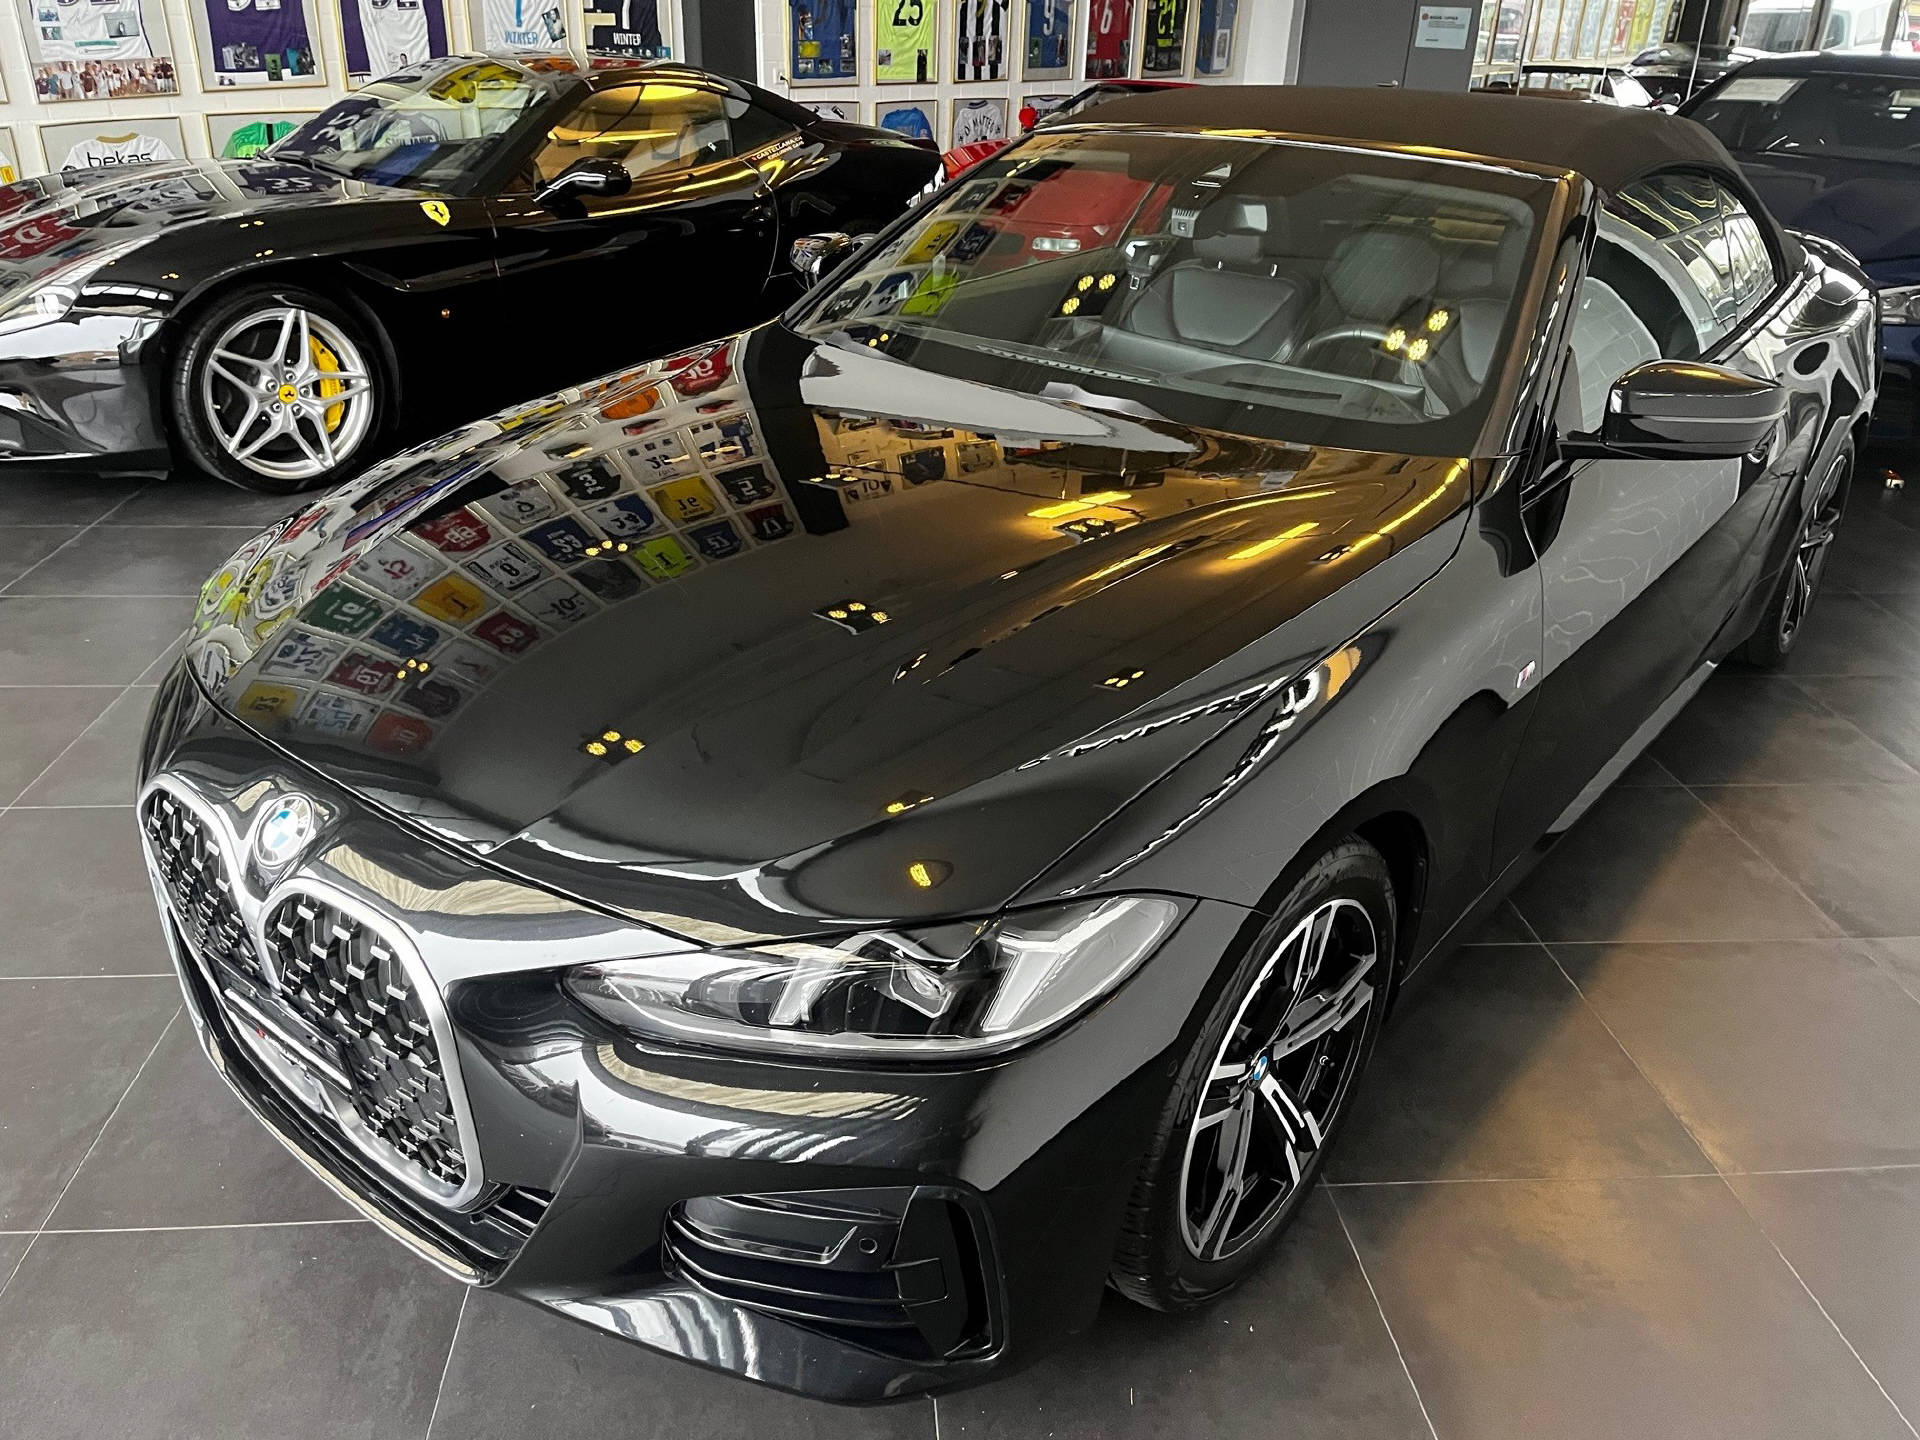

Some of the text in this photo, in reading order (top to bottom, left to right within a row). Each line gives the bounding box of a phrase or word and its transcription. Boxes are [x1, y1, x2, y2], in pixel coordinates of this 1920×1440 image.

[892, 0, 923, 26] 25
[505, 31, 538, 45] WINTER
[613, 32, 642, 46] WINTER
[86, 150, 153, 168] bekas
